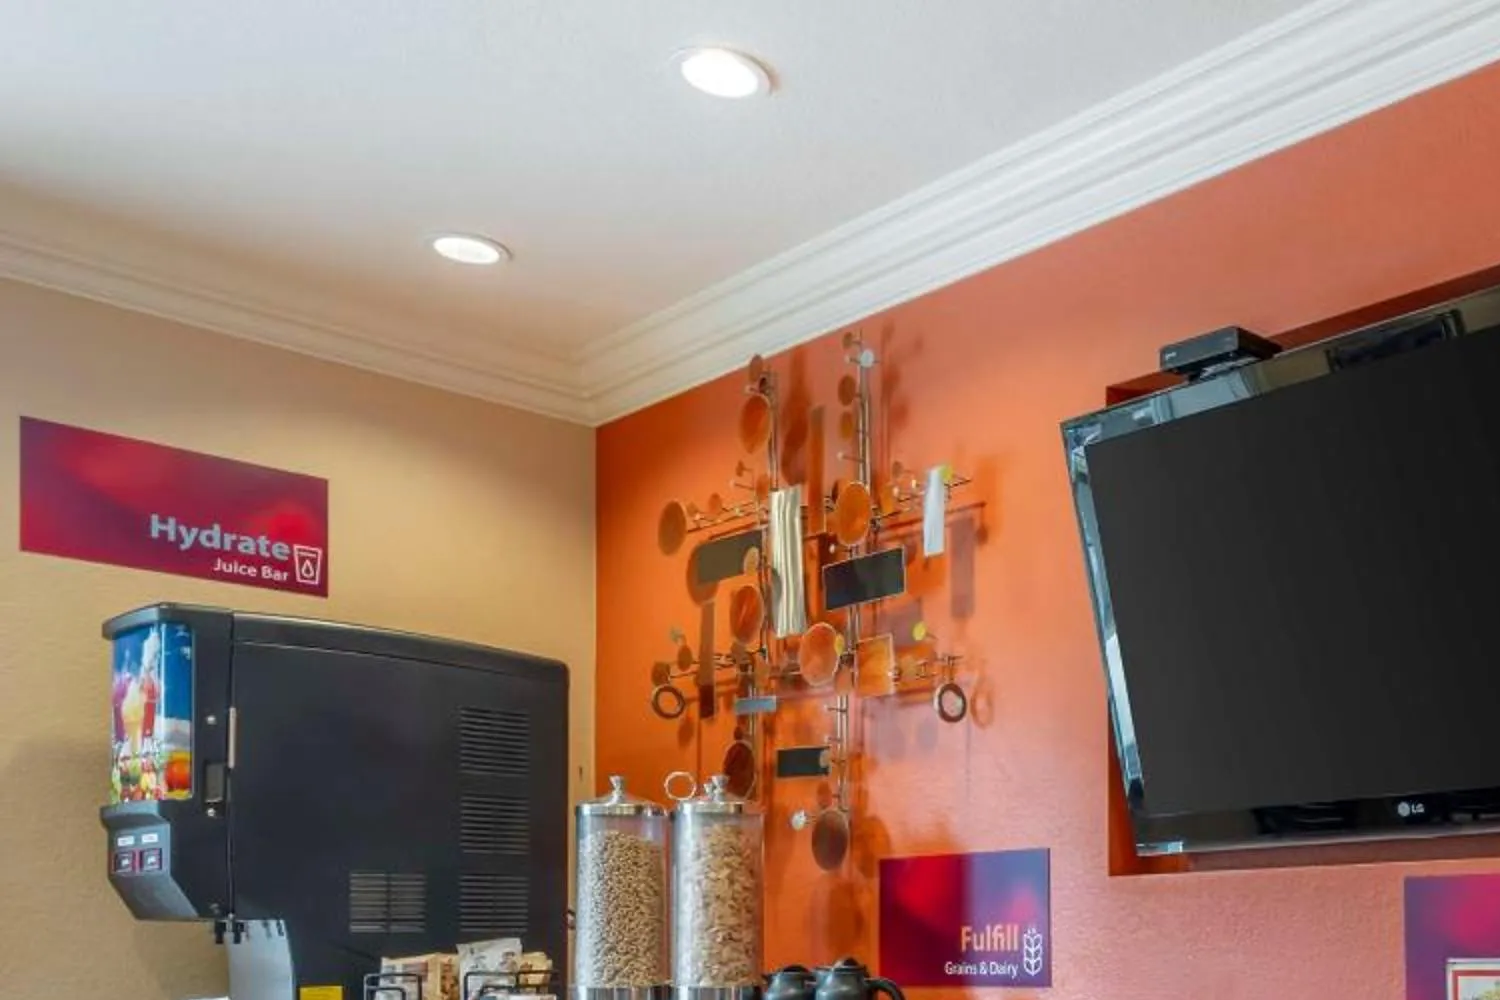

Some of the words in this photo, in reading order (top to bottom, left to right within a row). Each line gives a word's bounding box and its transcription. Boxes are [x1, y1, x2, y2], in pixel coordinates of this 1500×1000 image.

[150, 513, 291, 561] Hydrate
[213, 556, 257, 578] Juice
[261, 564, 289, 582] Bar
[960, 922, 1019, 953] Fulfill
[944, 960, 977, 976] Grains
[979, 960, 989, 975] &
[990, 960, 1019, 980] Dairy
